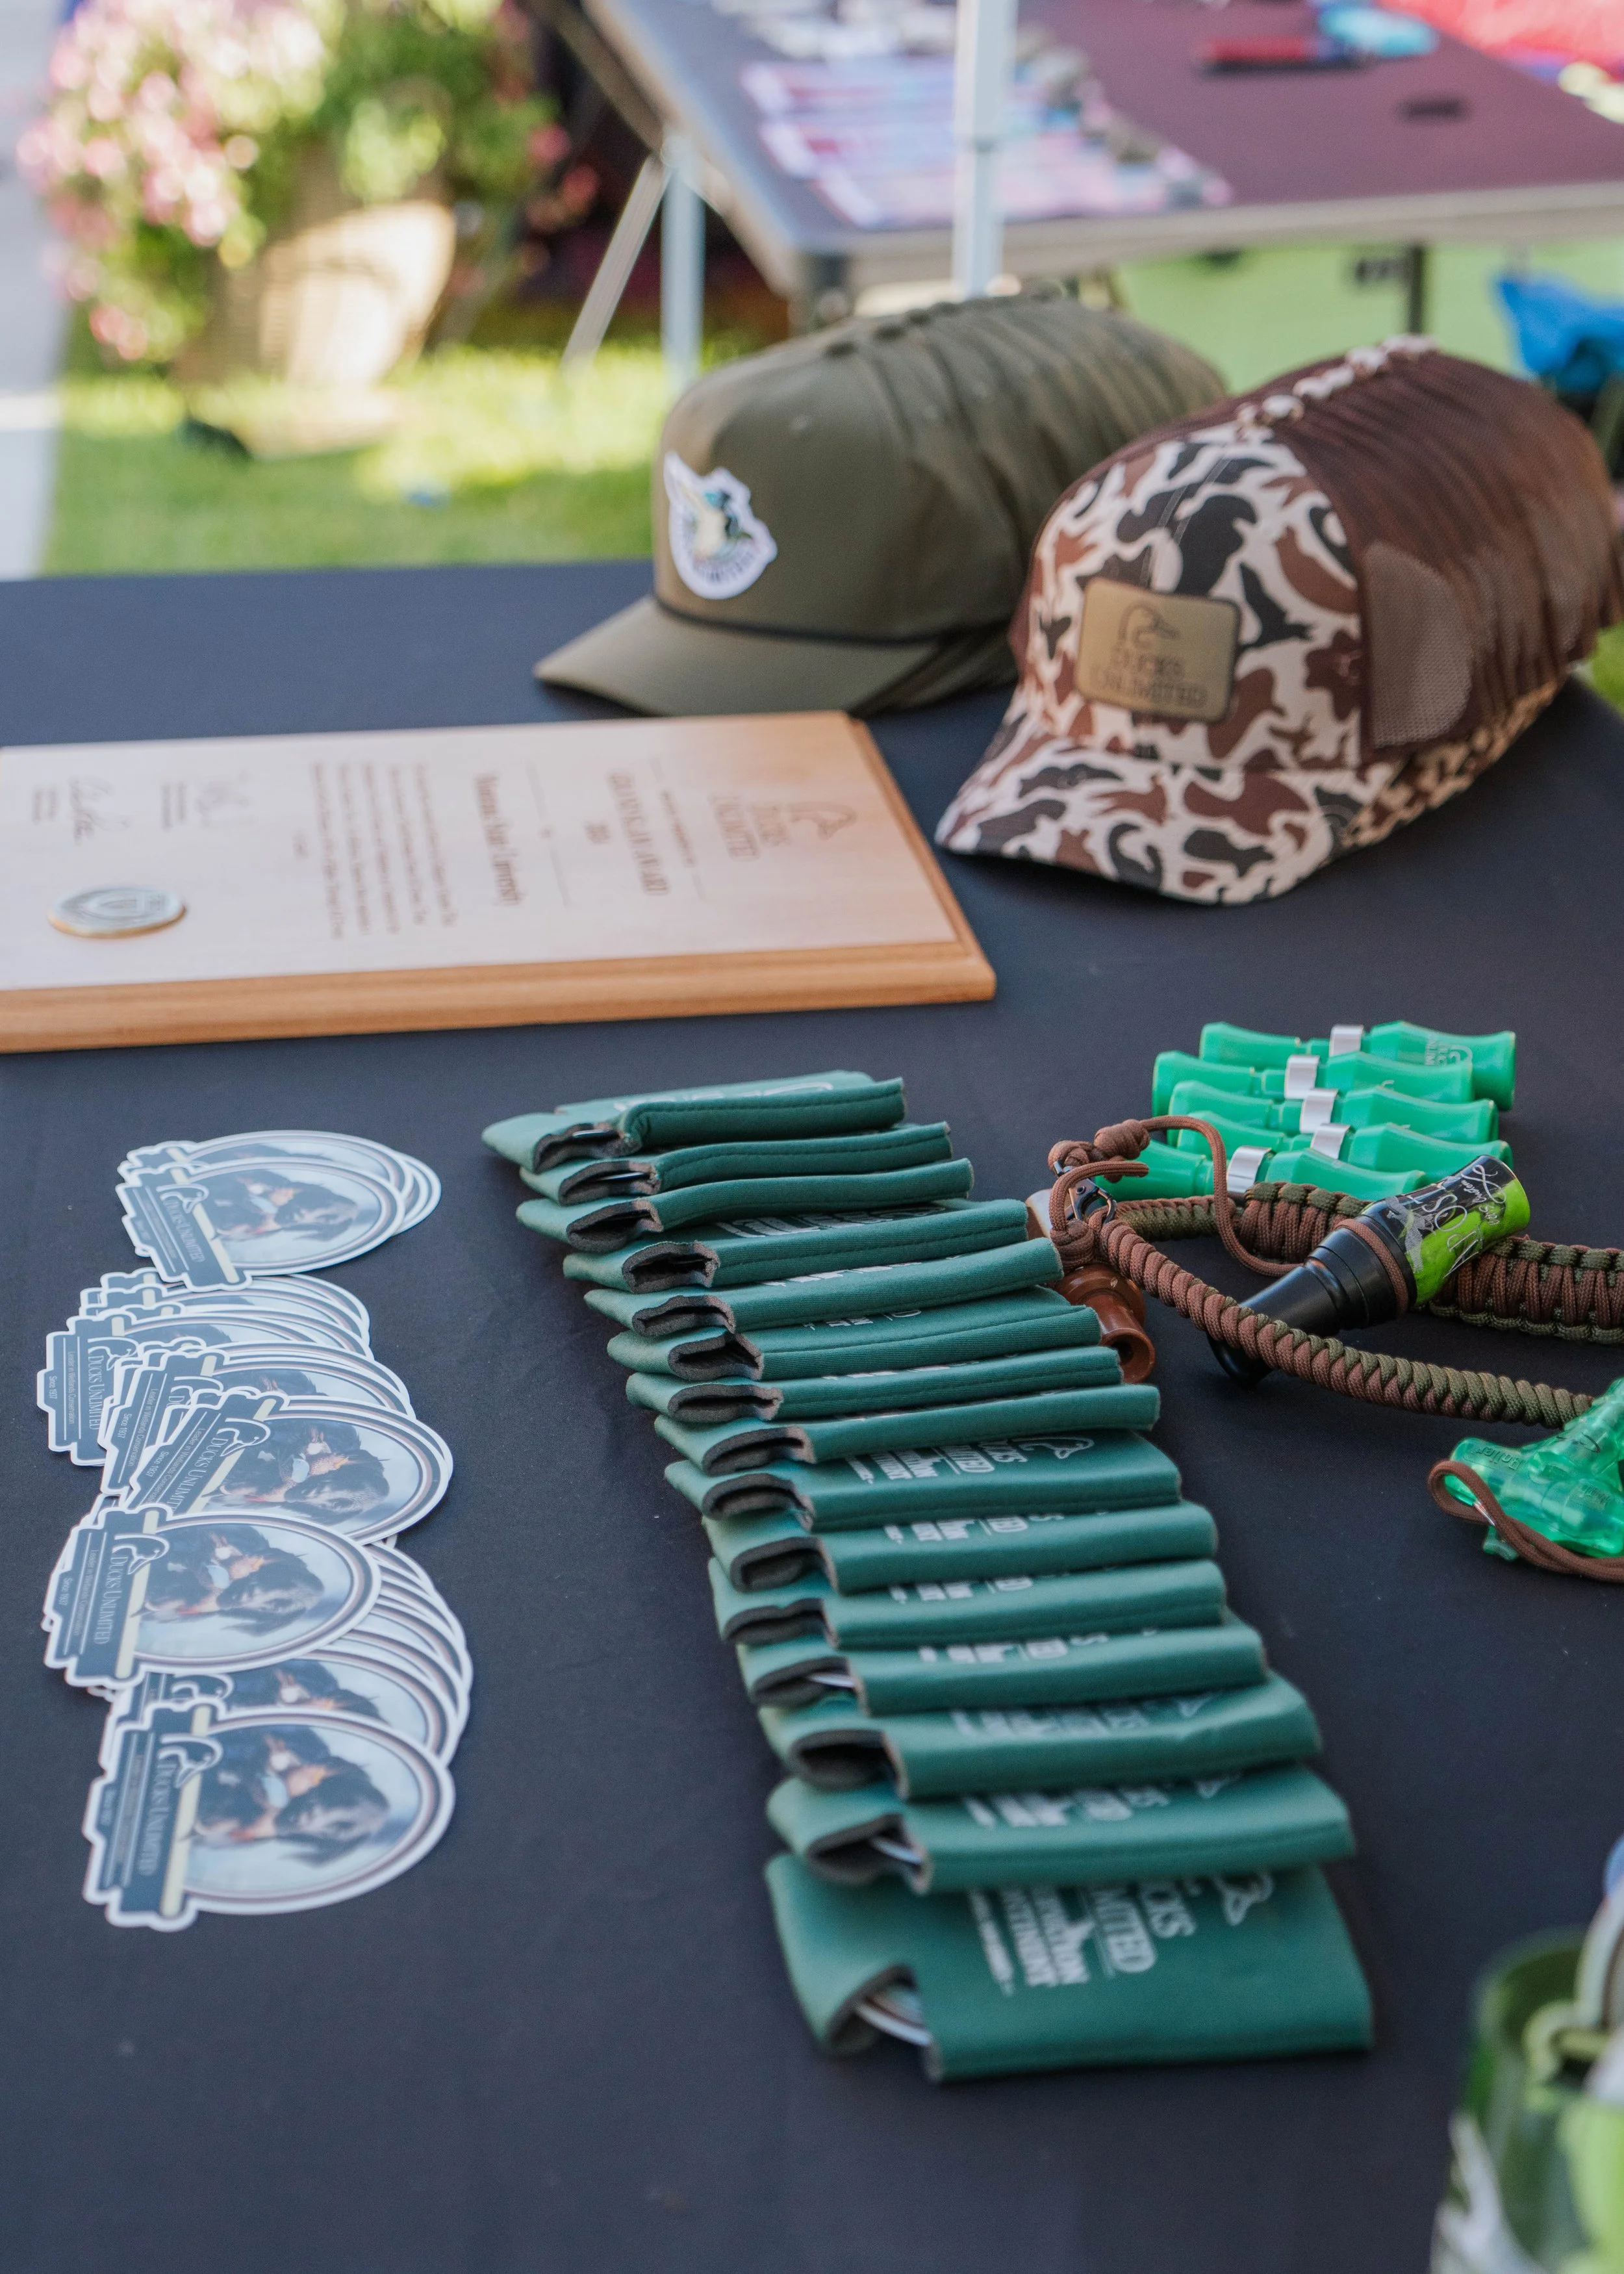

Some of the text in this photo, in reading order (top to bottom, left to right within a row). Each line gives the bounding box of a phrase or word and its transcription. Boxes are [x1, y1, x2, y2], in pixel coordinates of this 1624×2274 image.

[49, 1375, 57, 1399] Since 1937
[88, 1355, 105, 1429] DUCKS UNLIMITED
[147, 1389, 158, 1405] Leader
[118, 1414, 132, 1438] Since 1937
[138, 1411, 151, 1433] Wetlands
[186, 1429, 205, 1445] Leader
[128, 1435, 143, 1466] Conservation
[168, 1452, 190, 1473] Wetlands
[195, 1438, 228, 1467] DUCKS
[146, 1451, 168, 1477] Since 1937
[87, 1549, 98, 1567] Leader
[58, 1578, 72, 1605] Since 1937
[81, 1576, 92, 1599] Wetlands
[94, 1557, 129, 1644] DUCKS UNLIMITED
[73, 1601, 88, 1635] Conservation
